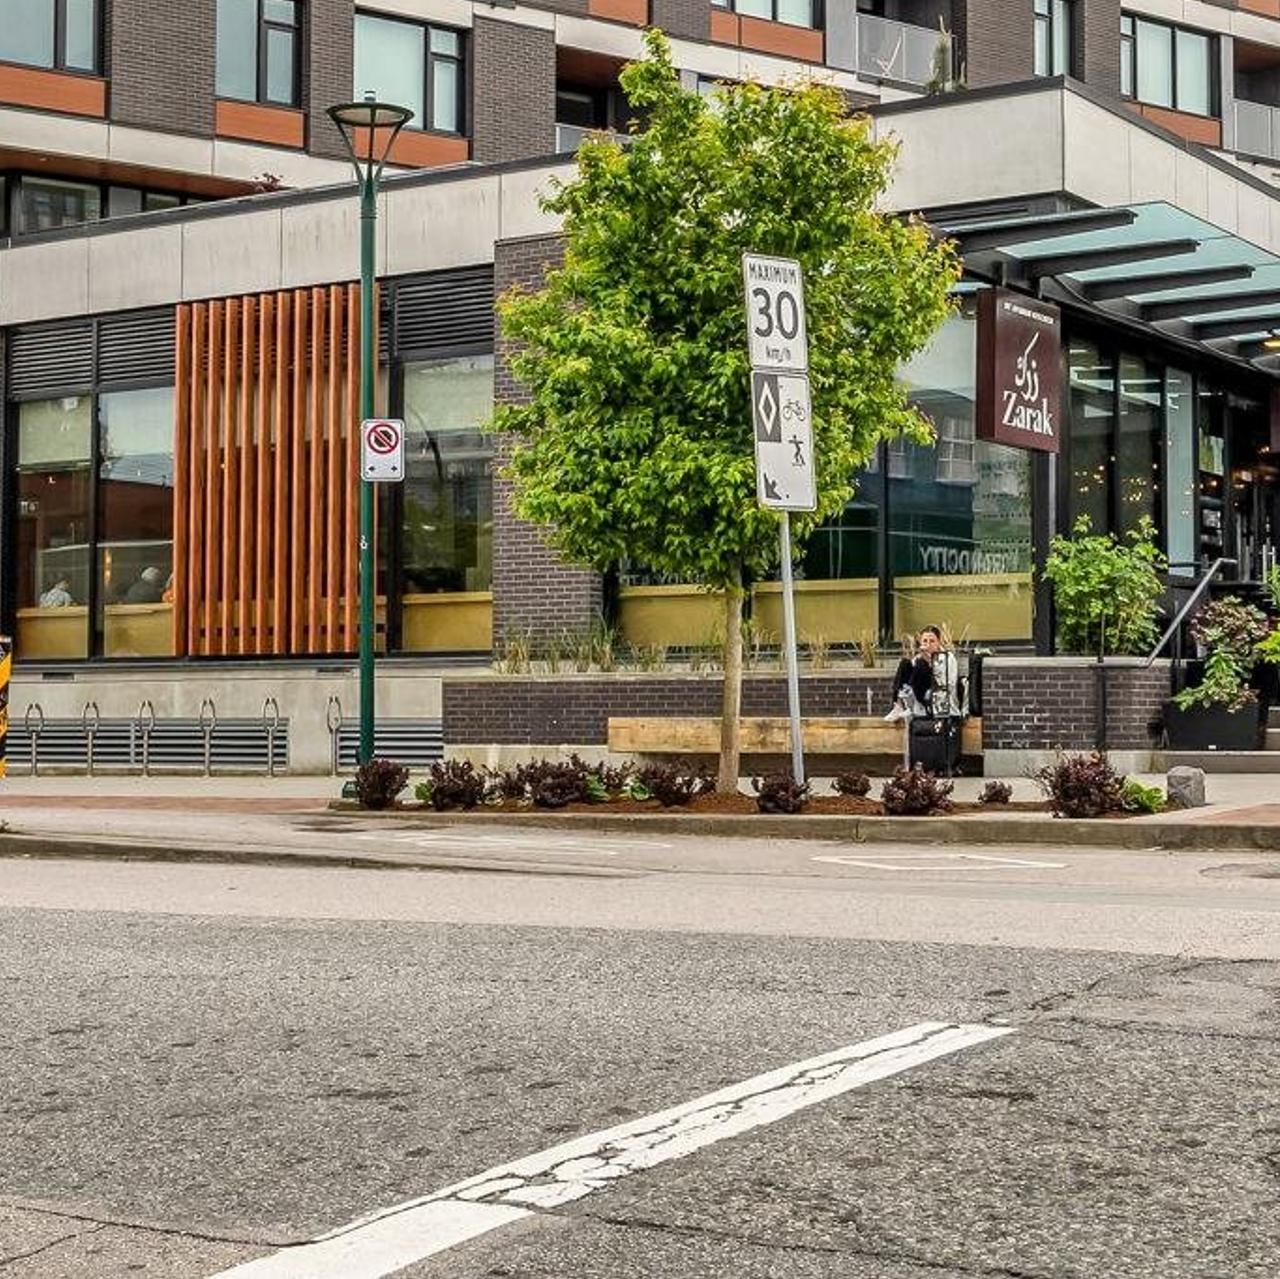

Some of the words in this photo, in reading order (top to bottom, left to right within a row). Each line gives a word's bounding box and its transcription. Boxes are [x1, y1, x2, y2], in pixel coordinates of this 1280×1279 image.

[748, 262, 798, 286] MAXIMUM
[752, 287, 799, 340] 30
[765, 344, 792, 363] km/h
[1002, 390, 1055, 437] Zarak
